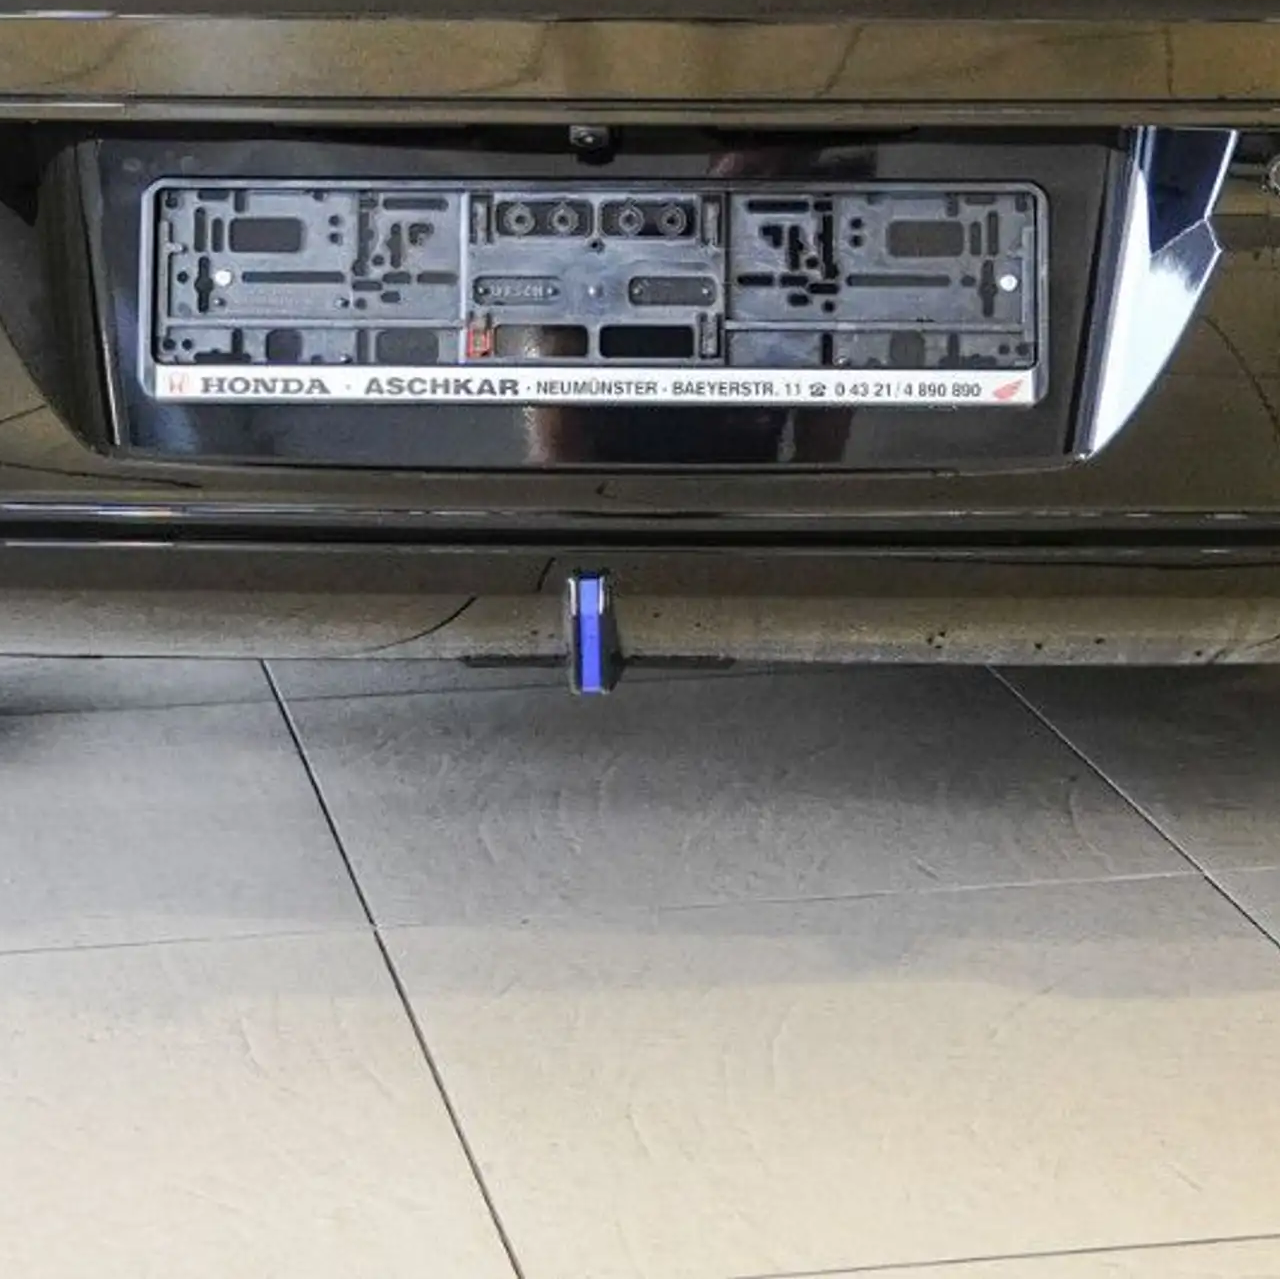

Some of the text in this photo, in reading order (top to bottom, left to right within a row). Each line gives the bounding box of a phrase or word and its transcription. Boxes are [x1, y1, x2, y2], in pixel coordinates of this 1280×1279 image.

[200, 377, 330, 395] HONDA
[364, 377, 519, 396] ASCHKAR
[536, 379, 658, 396] NEUMÜNSTER
[671, 380, 779, 397] BAEYERSTR.
[784, 382, 802, 397] 11
[848, 381, 870, 398] 43
[917, 382, 948, 398] 890
[951, 382, 983, 398] 890
